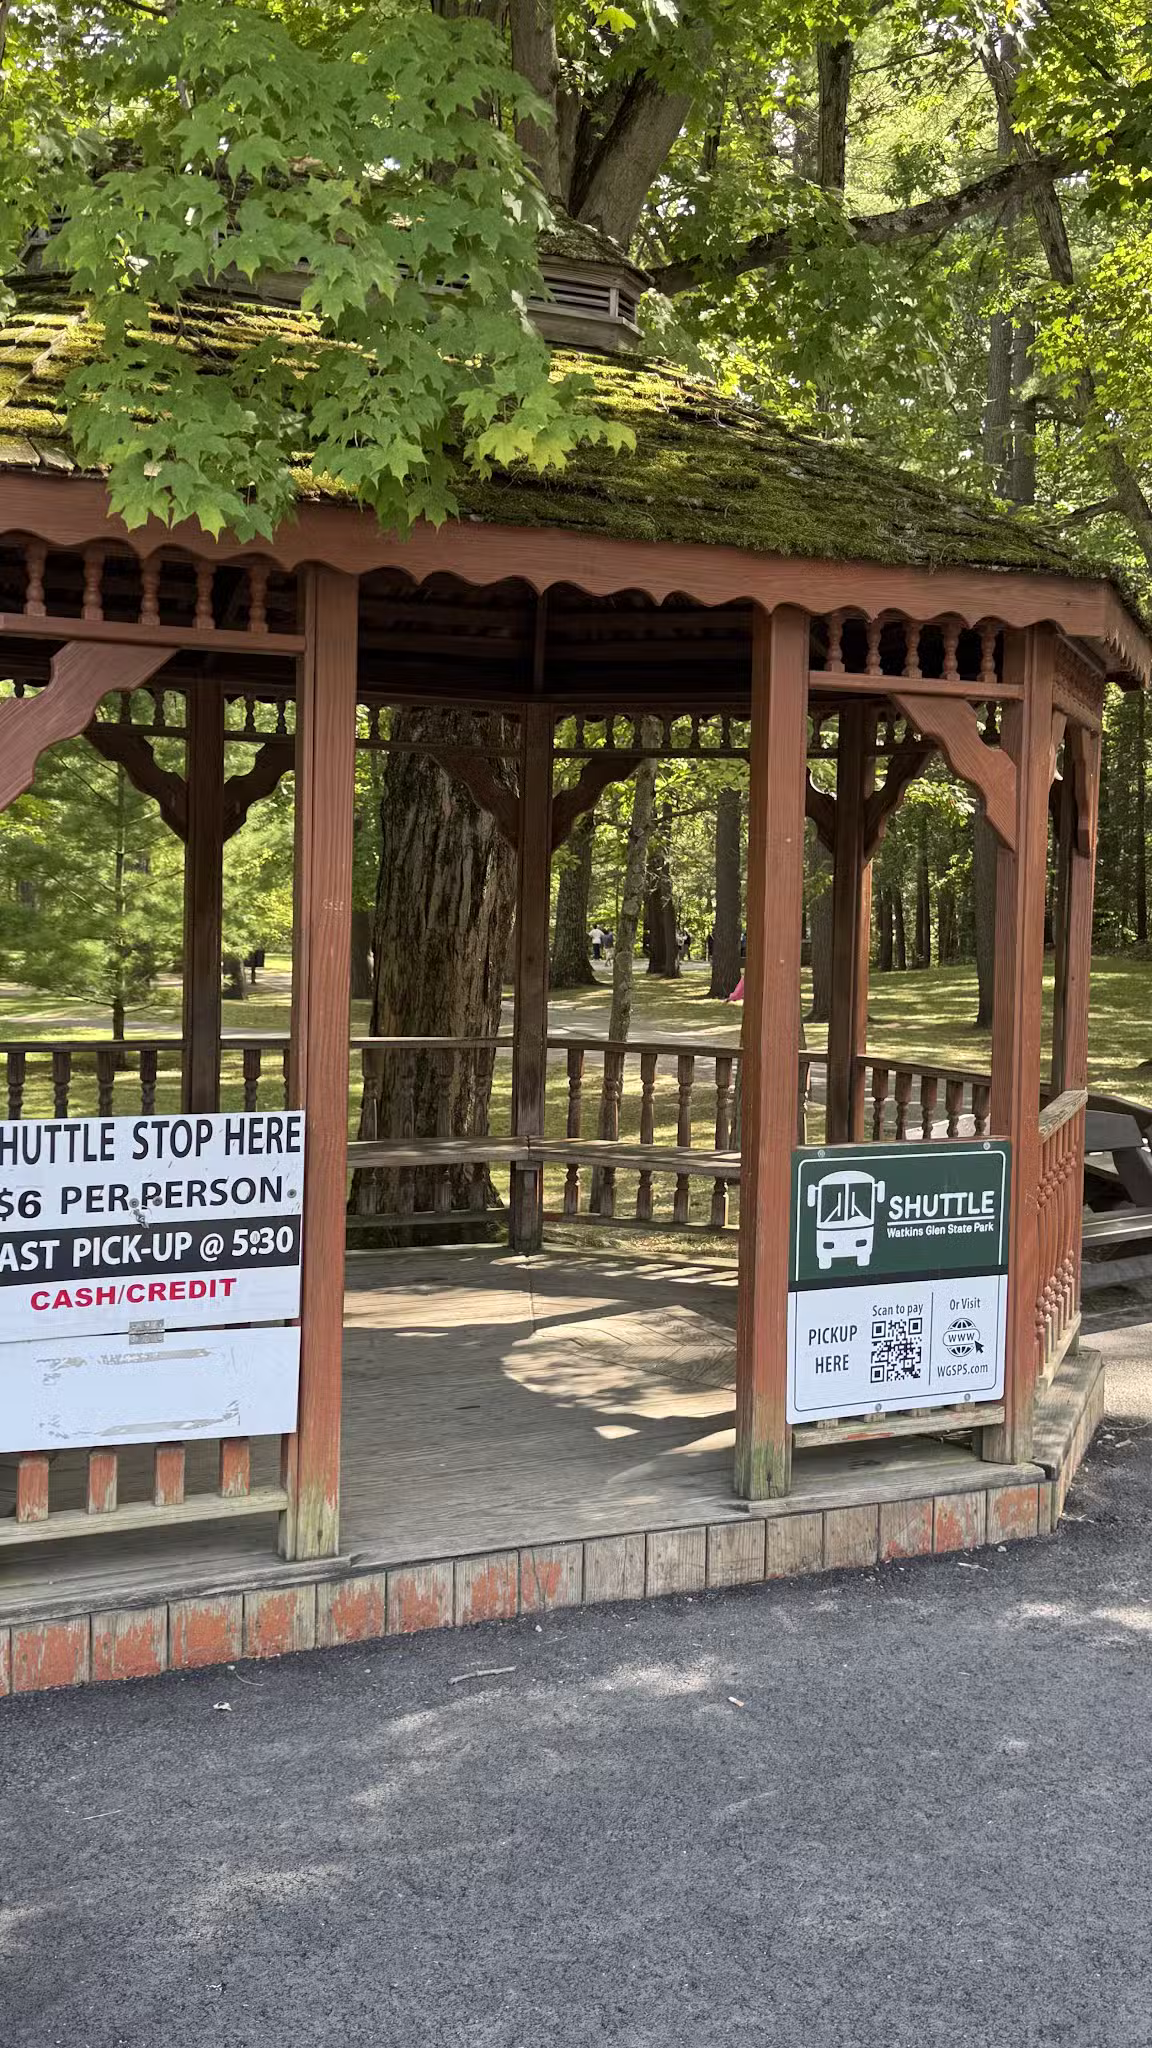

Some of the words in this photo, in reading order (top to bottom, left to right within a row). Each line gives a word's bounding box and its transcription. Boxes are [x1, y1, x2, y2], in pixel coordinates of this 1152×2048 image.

[132, 1120, 213, 1160] STOP
[226, 1117, 301, 1156] HERE
[0, 1188, 42, 1222] $6
[61, 1184, 129, 1214] PER
[141, 1176, 283, 1209] PERSON
[888, 1191, 994, 1220] SHUTTLE
[887, 1227, 923, 1238] Watkins
[926, 1225, 946, 1236] Glen
[948, 1223, 972, 1234] State
[974, 1222, 994, 1232] Park
[73, 1232, 192, 1268] PICK-UP
[199, 1233, 224, 1262] @
[232, 1226, 294, 1257] 5:30
[31, 1278, 237, 1311] CASH/CREDIT
[950, 1299, 959, 1310] Or
[961, 1298, 981, 1309] Visit
[872, 1305, 894, 1316] Scan
[896, 1304, 904, 1314] to
[907, 1303, 923, 1316] pay
[808, 1325, 858, 1346] PICKUP
[948, 1332, 974, 1342] www
[815, 1354, 849, 1374] HERE
[937, 1364, 988, 1378] WGSPS.com
